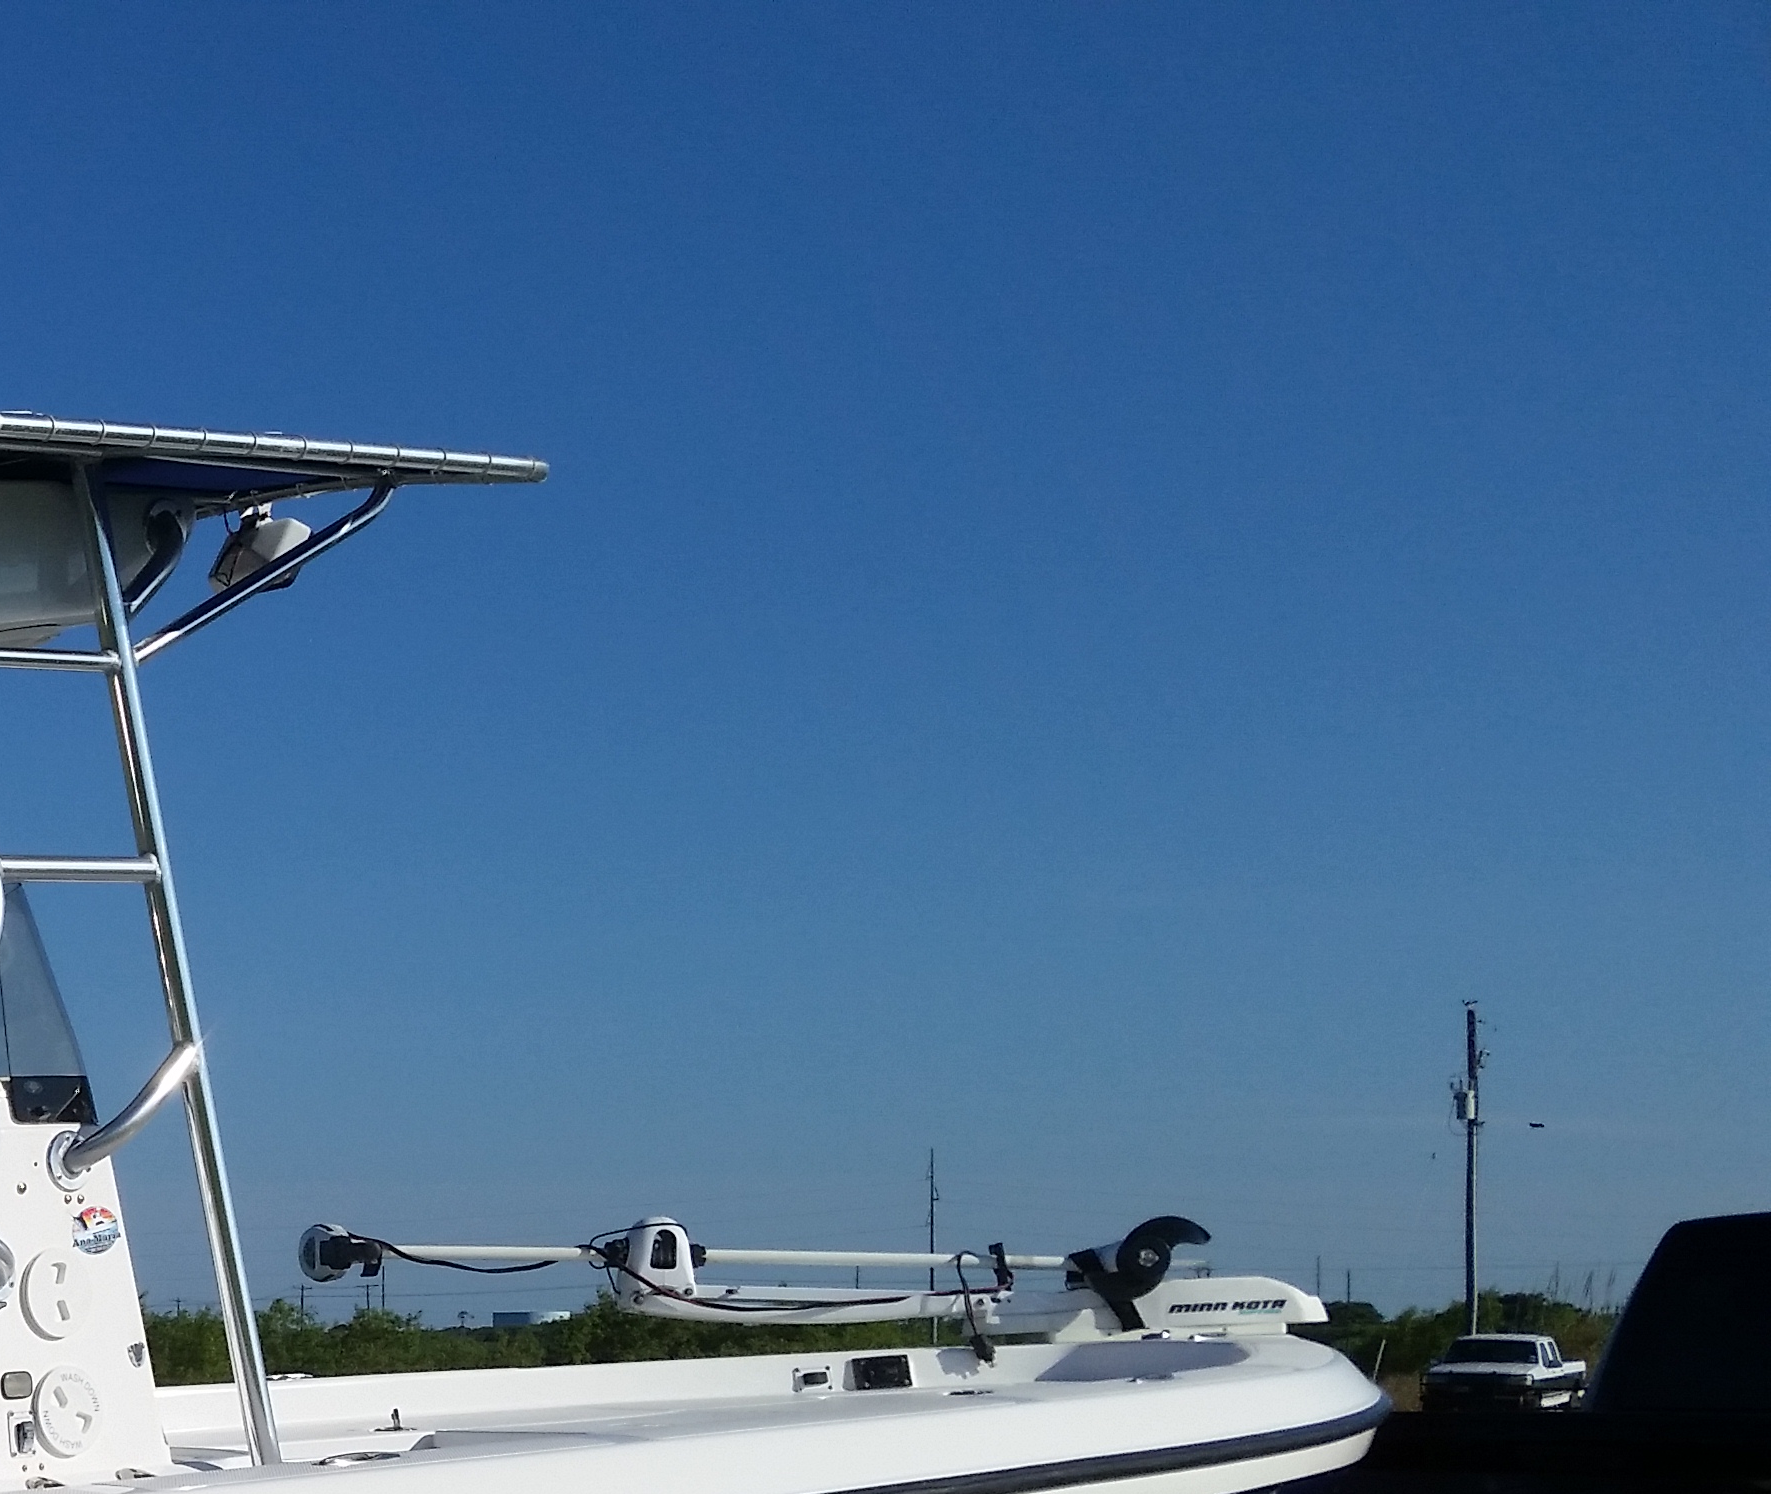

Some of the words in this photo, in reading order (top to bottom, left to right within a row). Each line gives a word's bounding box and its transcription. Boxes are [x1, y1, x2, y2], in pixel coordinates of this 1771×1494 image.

[60, 1373, 84, 1384] WASH
[83, 1381, 100, 1412] DOWN
[42, 1410, 60, 1441] DOWN
[59, 1439, 83, 1449] WASH
